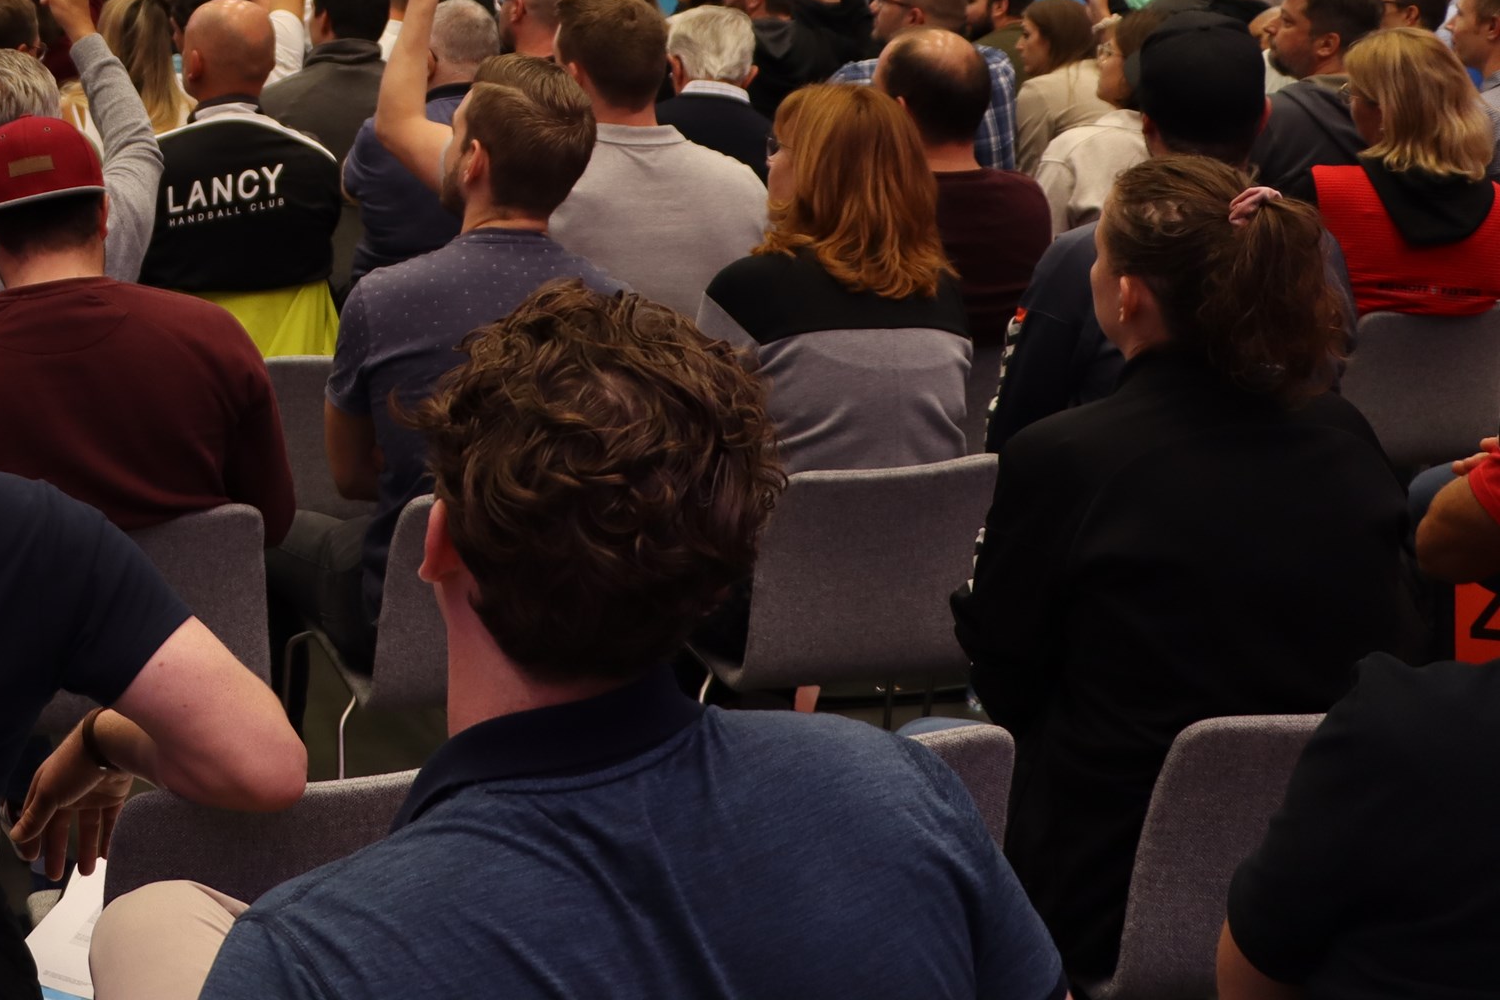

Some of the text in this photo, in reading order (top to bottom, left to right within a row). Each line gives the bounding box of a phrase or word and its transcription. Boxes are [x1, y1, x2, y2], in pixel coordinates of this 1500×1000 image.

[167, 163, 284, 213] LANCY
[169, 197, 285, 227] HANDBALL CLUB
